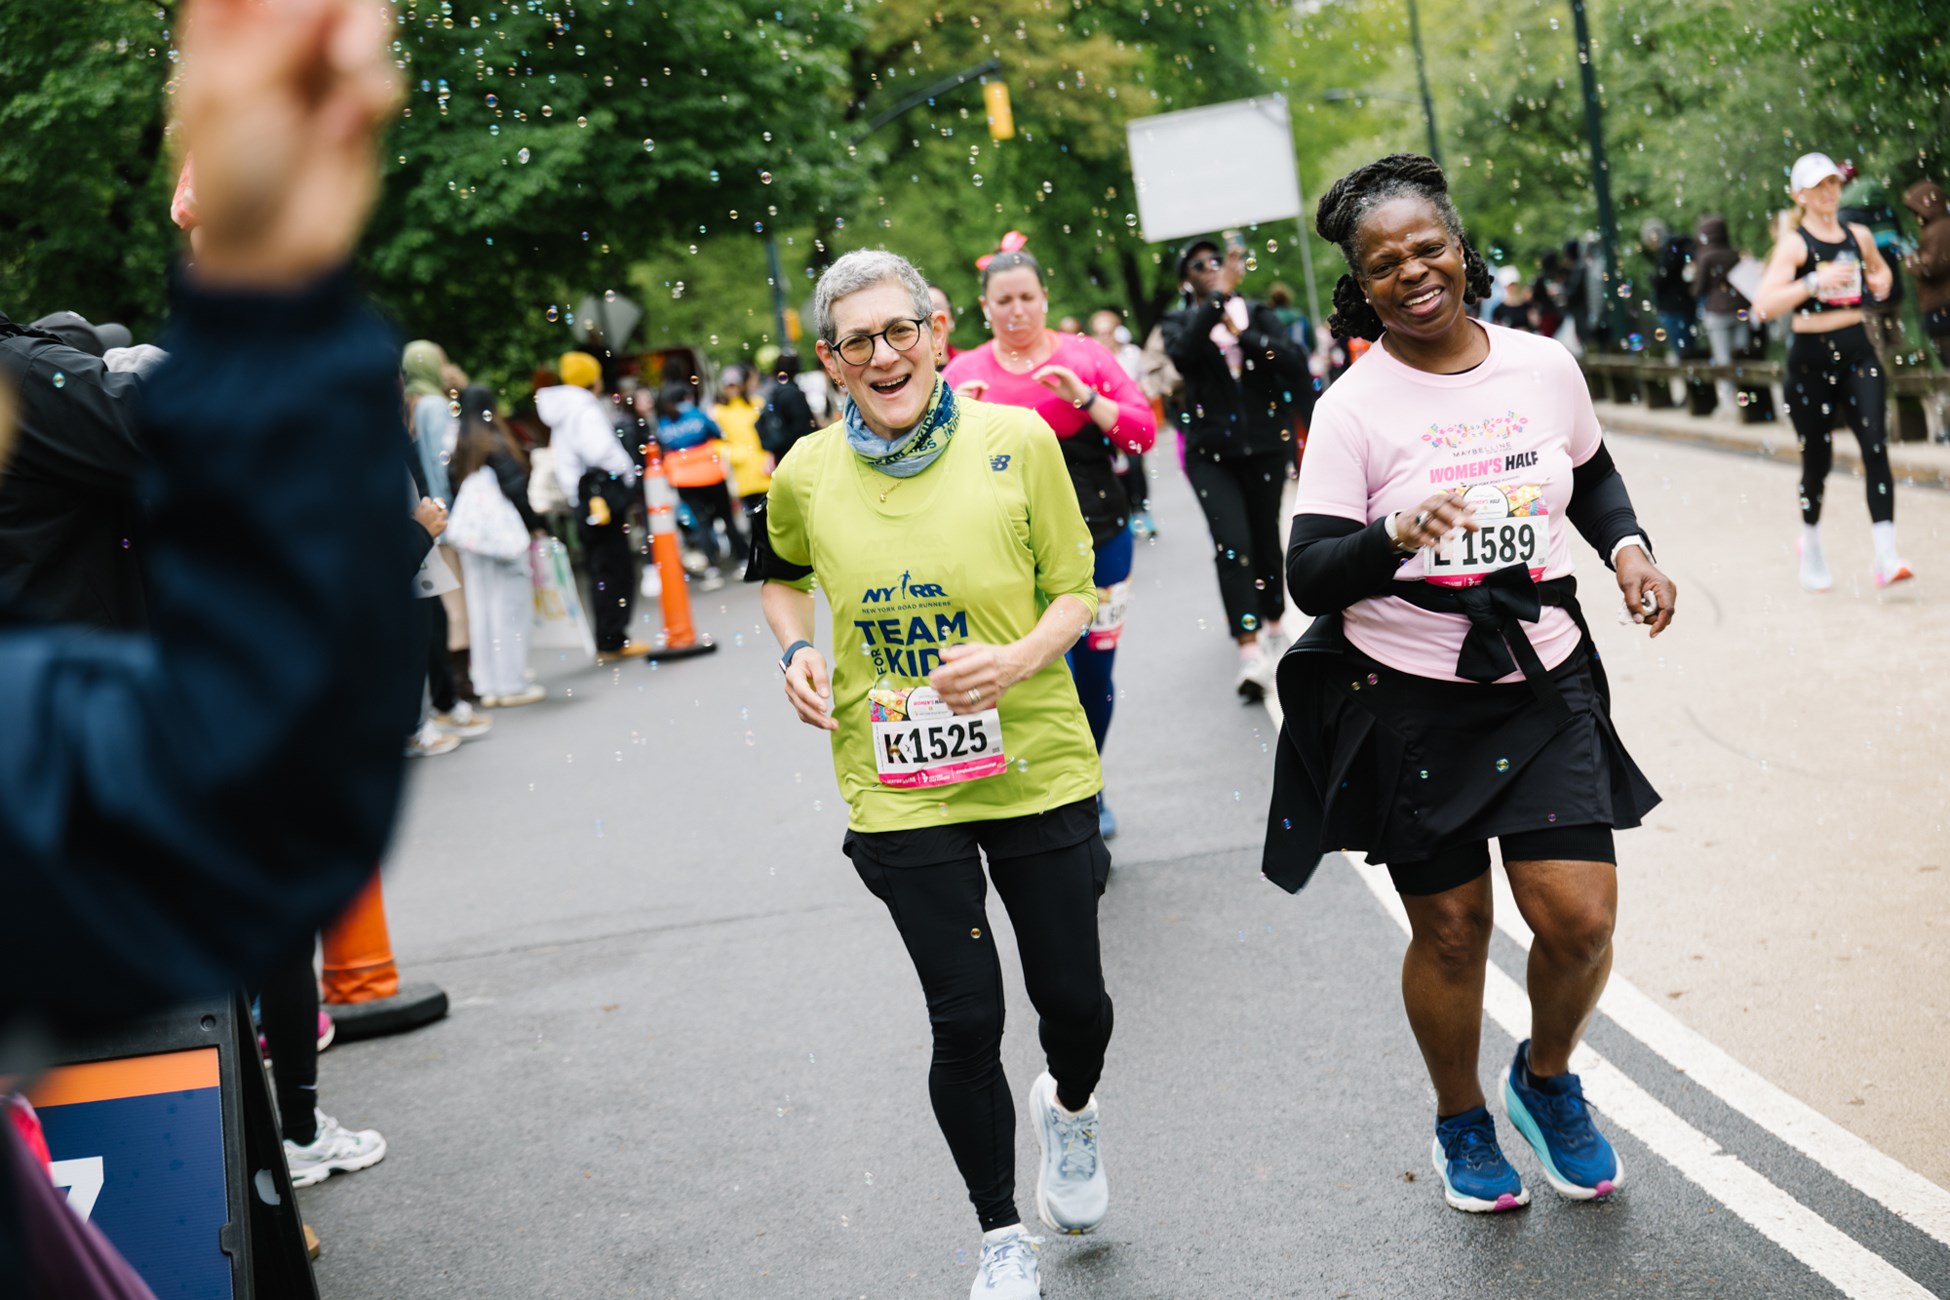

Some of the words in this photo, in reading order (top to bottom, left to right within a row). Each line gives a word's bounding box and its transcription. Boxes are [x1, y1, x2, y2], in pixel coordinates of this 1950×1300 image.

[1430, 457, 1502, 484] WOMEN'S
[1505, 451, 1539, 471] HALF
[1453, 442, 1512, 457] MAYBELLINE
[1462, 524, 1535, 566] 1589
[854, 610, 968, 646] TEAM
[871, 648, 887, 676] FOR
[884, 642, 967, 678] KID
[884, 720, 988, 764] K1525
